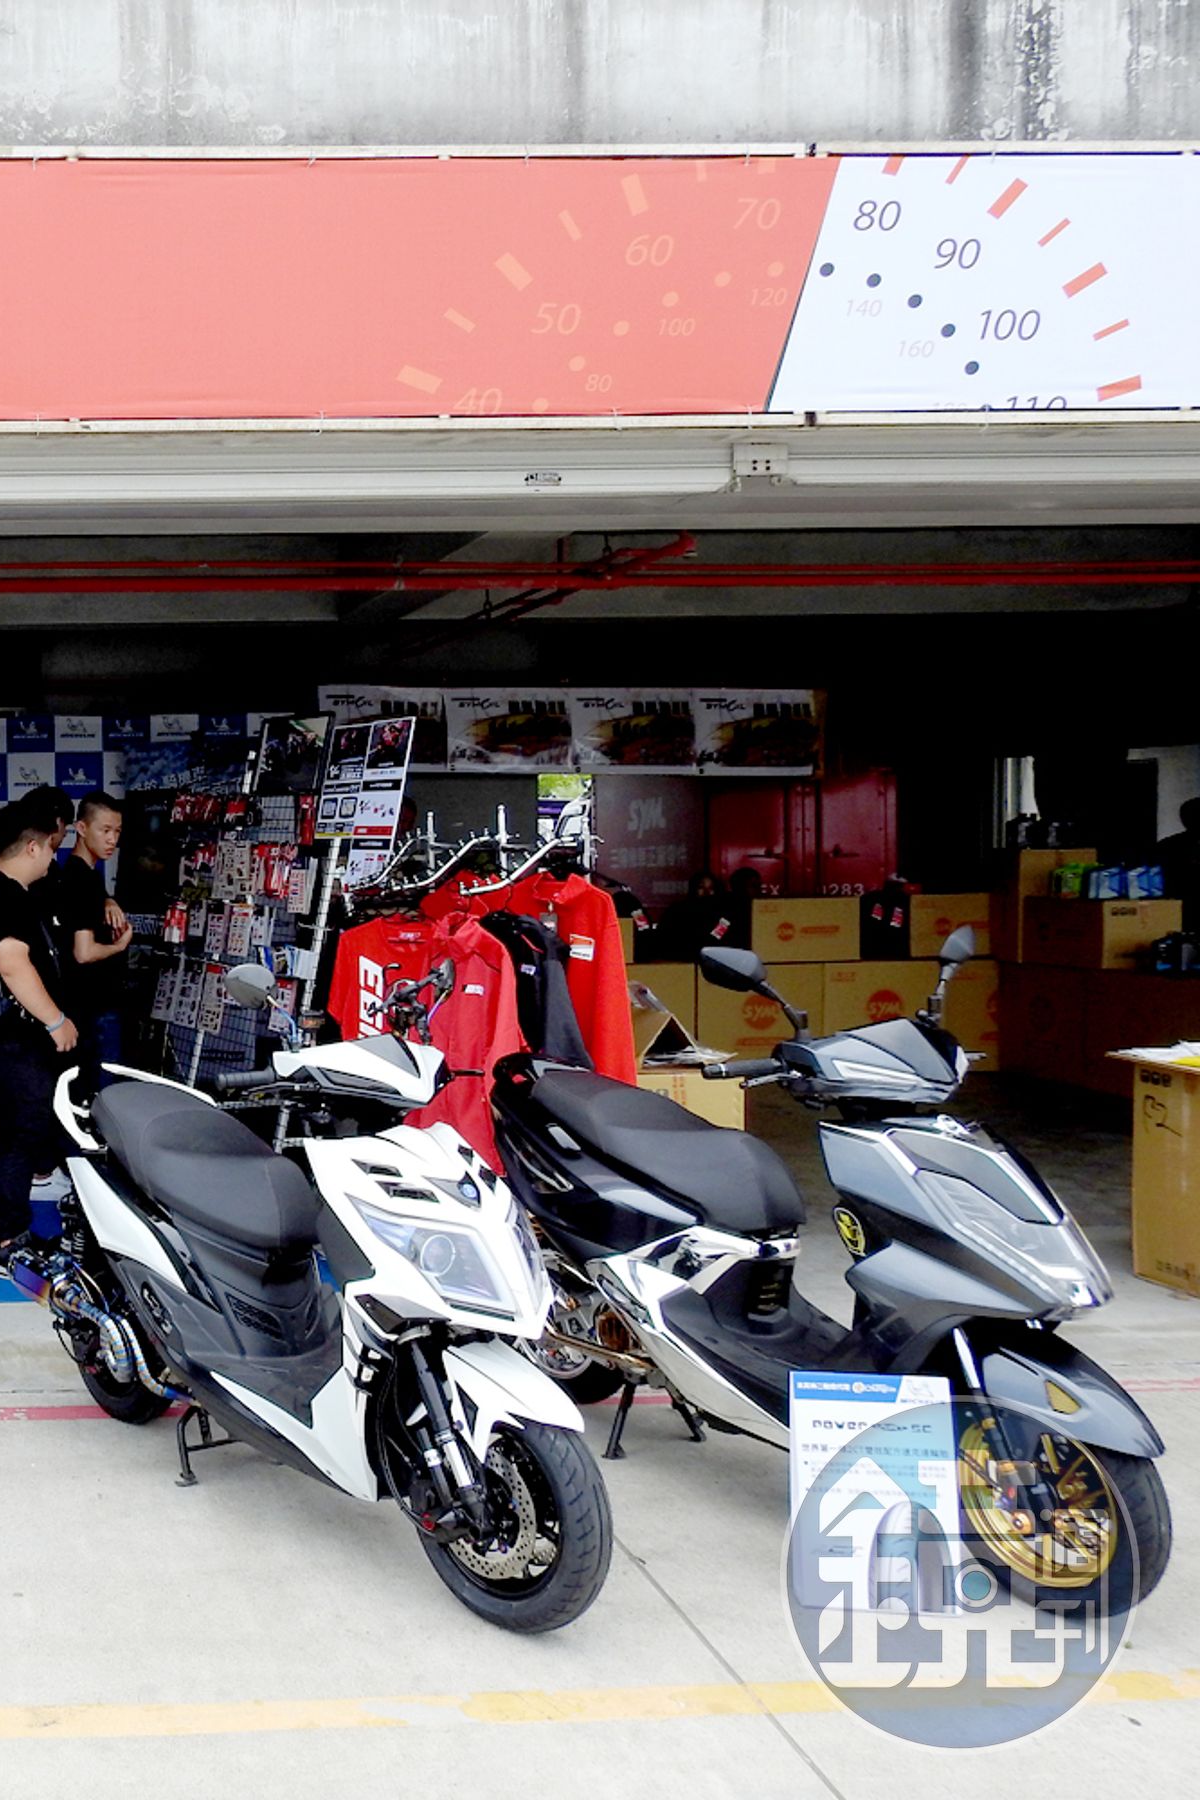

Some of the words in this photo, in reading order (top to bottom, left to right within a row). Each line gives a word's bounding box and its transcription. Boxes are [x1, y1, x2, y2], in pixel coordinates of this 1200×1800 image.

[735, 198, 782, 230] 70
[852, 200, 902, 232] 80
[625, 234, 674, 267] 60
[934, 238, 981, 271] 90
[749, 288, 788, 307] 120
[846, 299, 883, 319] 140
[532, 302, 581, 335] 50
[658, 318, 696, 337] 100
[978, 309, 1041, 342] 100
[898, 339, 935, 359] 160
[585, 373, 612, 393] 80
[453, 387, 503, 414] 40
